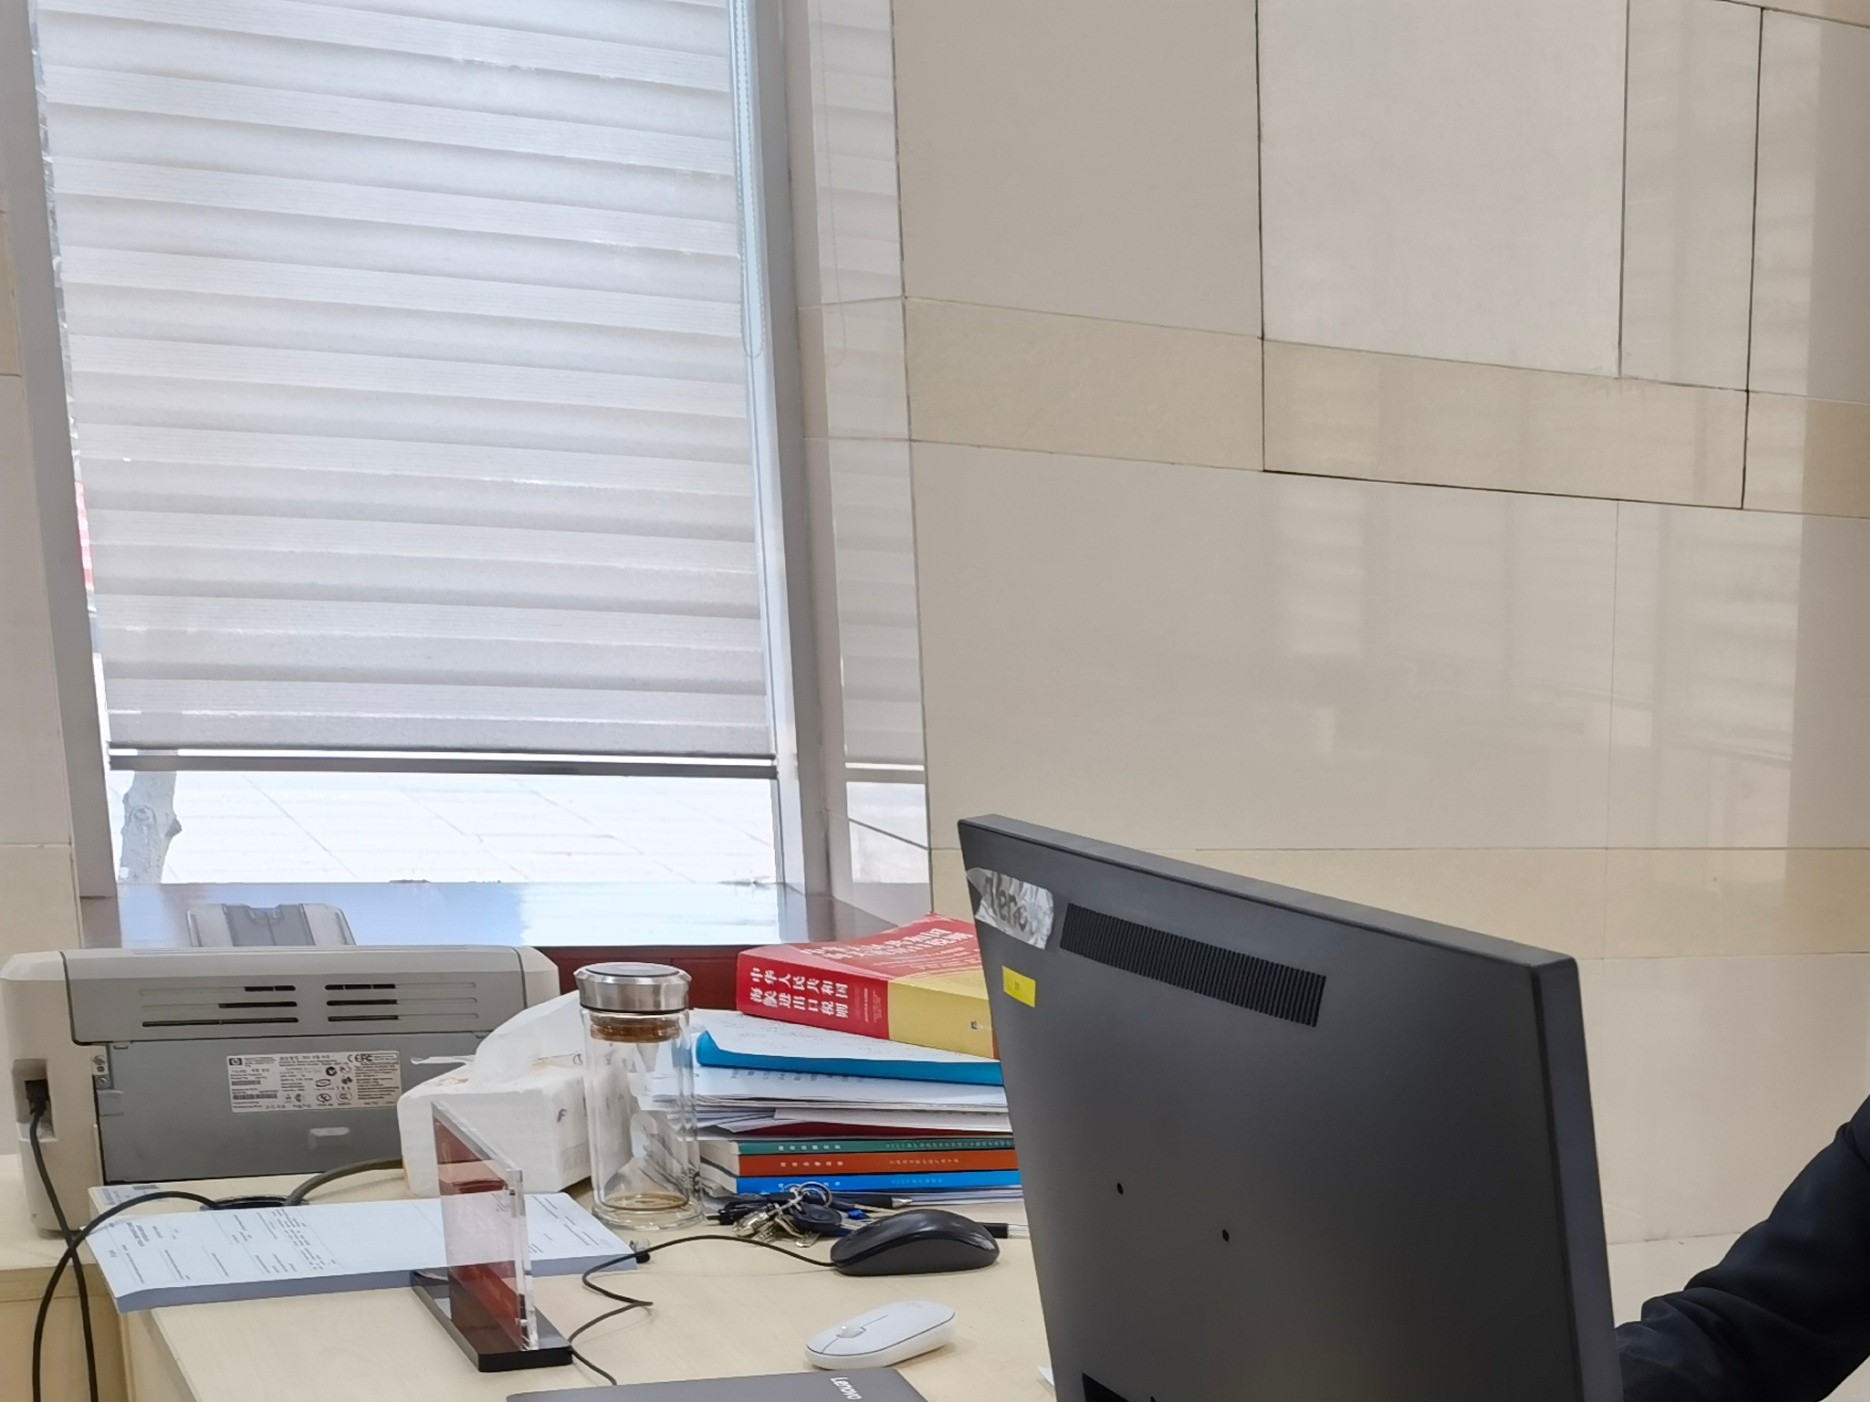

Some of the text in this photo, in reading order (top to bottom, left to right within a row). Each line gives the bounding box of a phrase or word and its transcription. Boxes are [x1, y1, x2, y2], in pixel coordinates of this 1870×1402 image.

[750, 967, 849, 999] 中华人民共和国
[750, 986, 849, 1019] 海关进出口税则
[829, 1376, 863, 1401] Lenovo
